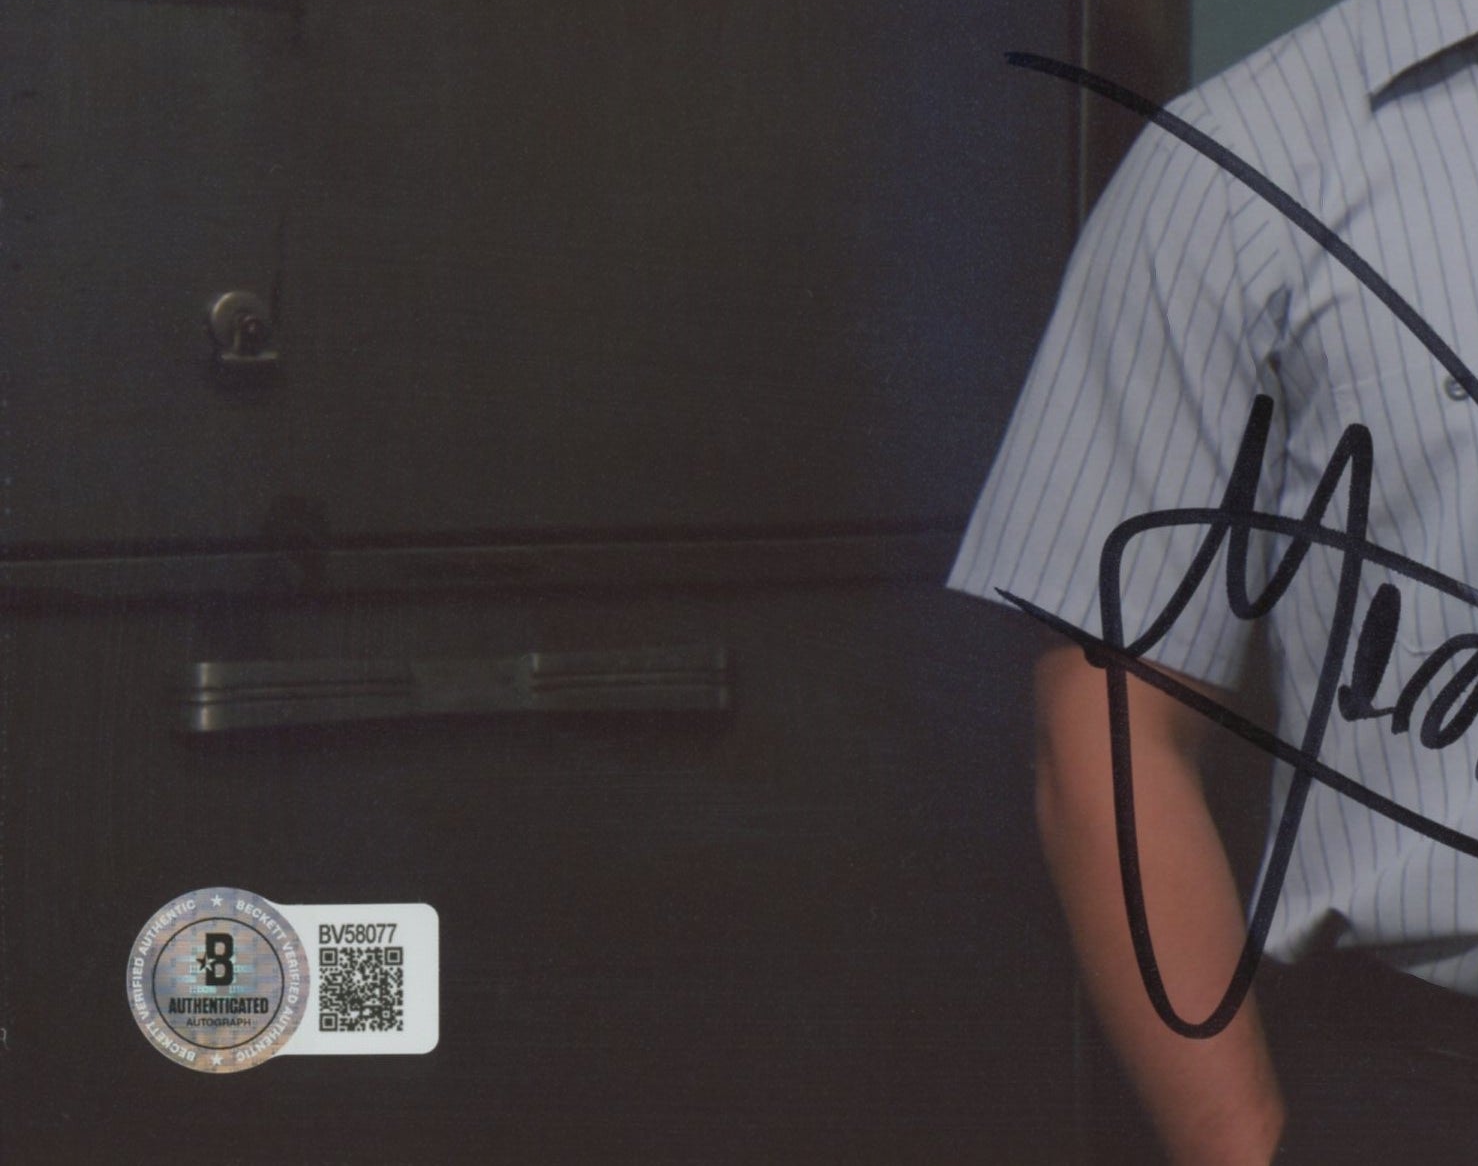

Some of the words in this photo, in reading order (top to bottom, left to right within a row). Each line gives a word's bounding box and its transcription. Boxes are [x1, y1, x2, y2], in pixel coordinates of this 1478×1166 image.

[139, 899, 197, 956] AUTHENTIC
[236, 899, 287, 940] BECKETT
[318, 923, 398, 945] BV58077
[205, 932, 234, 986] B
[282, 941, 300, 1004] VERIFIED
[132, 956, 150, 1021] VERIFIED
[168, 998, 269, 1015] AUTHENTICATED
[146, 1021, 197, 1062] BECKETT
[186, 1017, 252, 1027] AUTOGRAPH
[236, 1006, 292, 1062] AUTHENTIC
